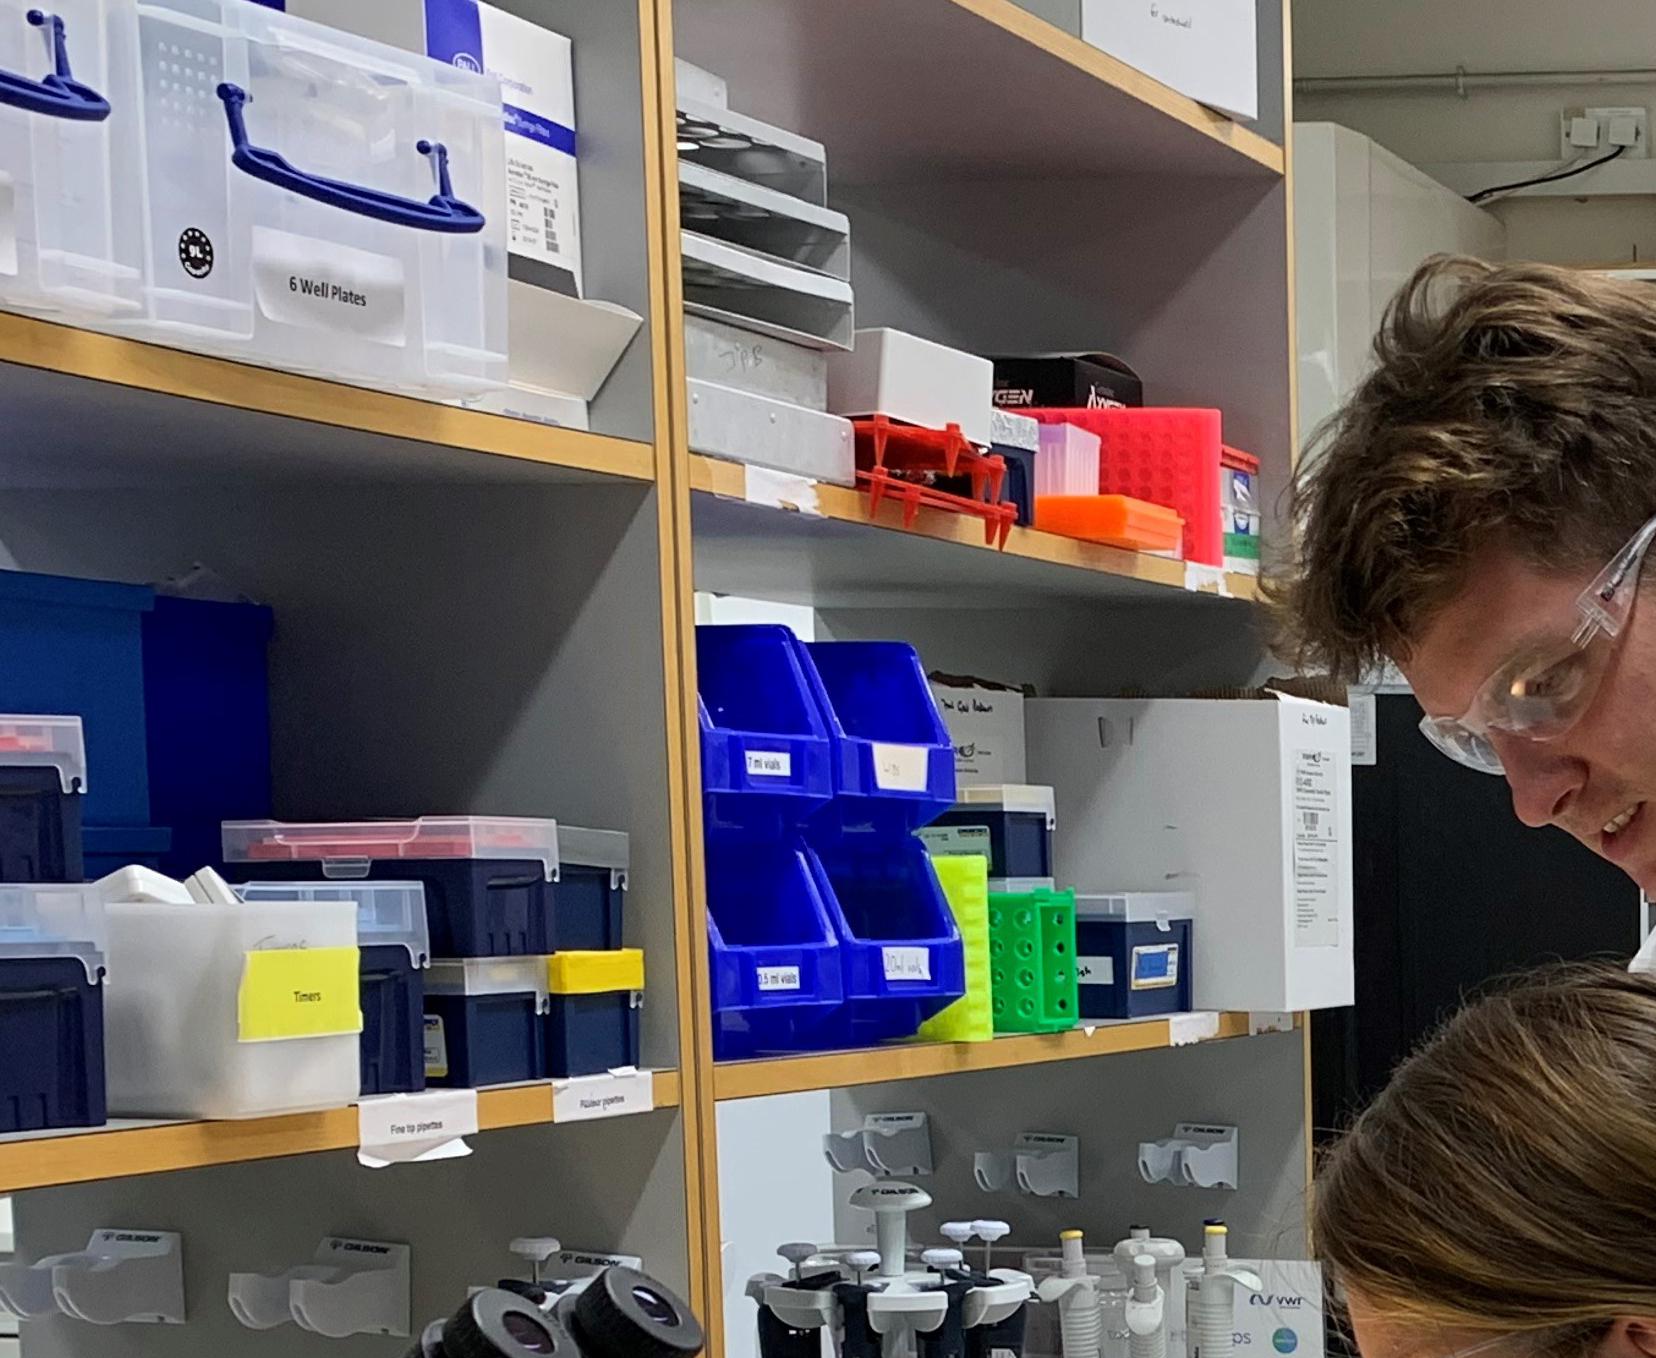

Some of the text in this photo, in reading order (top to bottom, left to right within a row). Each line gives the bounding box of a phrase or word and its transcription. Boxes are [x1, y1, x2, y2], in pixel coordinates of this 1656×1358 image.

[289, 276, 368, 307] 6 Well Plates
[293, 990, 322, 1003] Timers
[390, 1123, 405, 1135] Fine
[416, 1119, 443, 1135] pipettes
